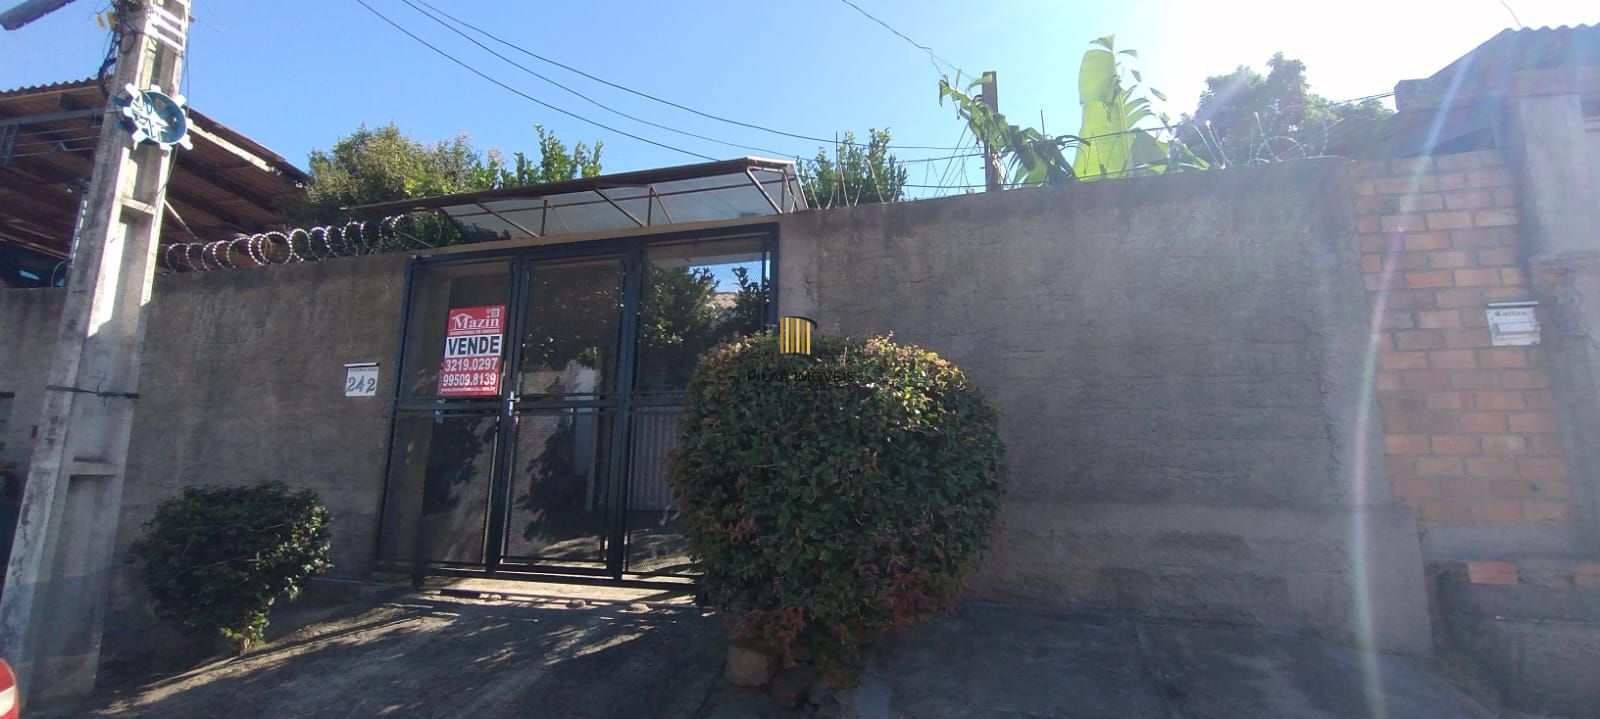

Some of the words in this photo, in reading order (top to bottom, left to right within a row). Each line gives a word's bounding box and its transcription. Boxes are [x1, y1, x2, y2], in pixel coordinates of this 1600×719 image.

[453, 313, 499, 330] Mazin
[448, 335, 500, 355] VENDE
[445, 357, 498, 371] 3219.0297
[347, 375, 376, 393] 242
[442, 372, 497, 387] 99509.8139
